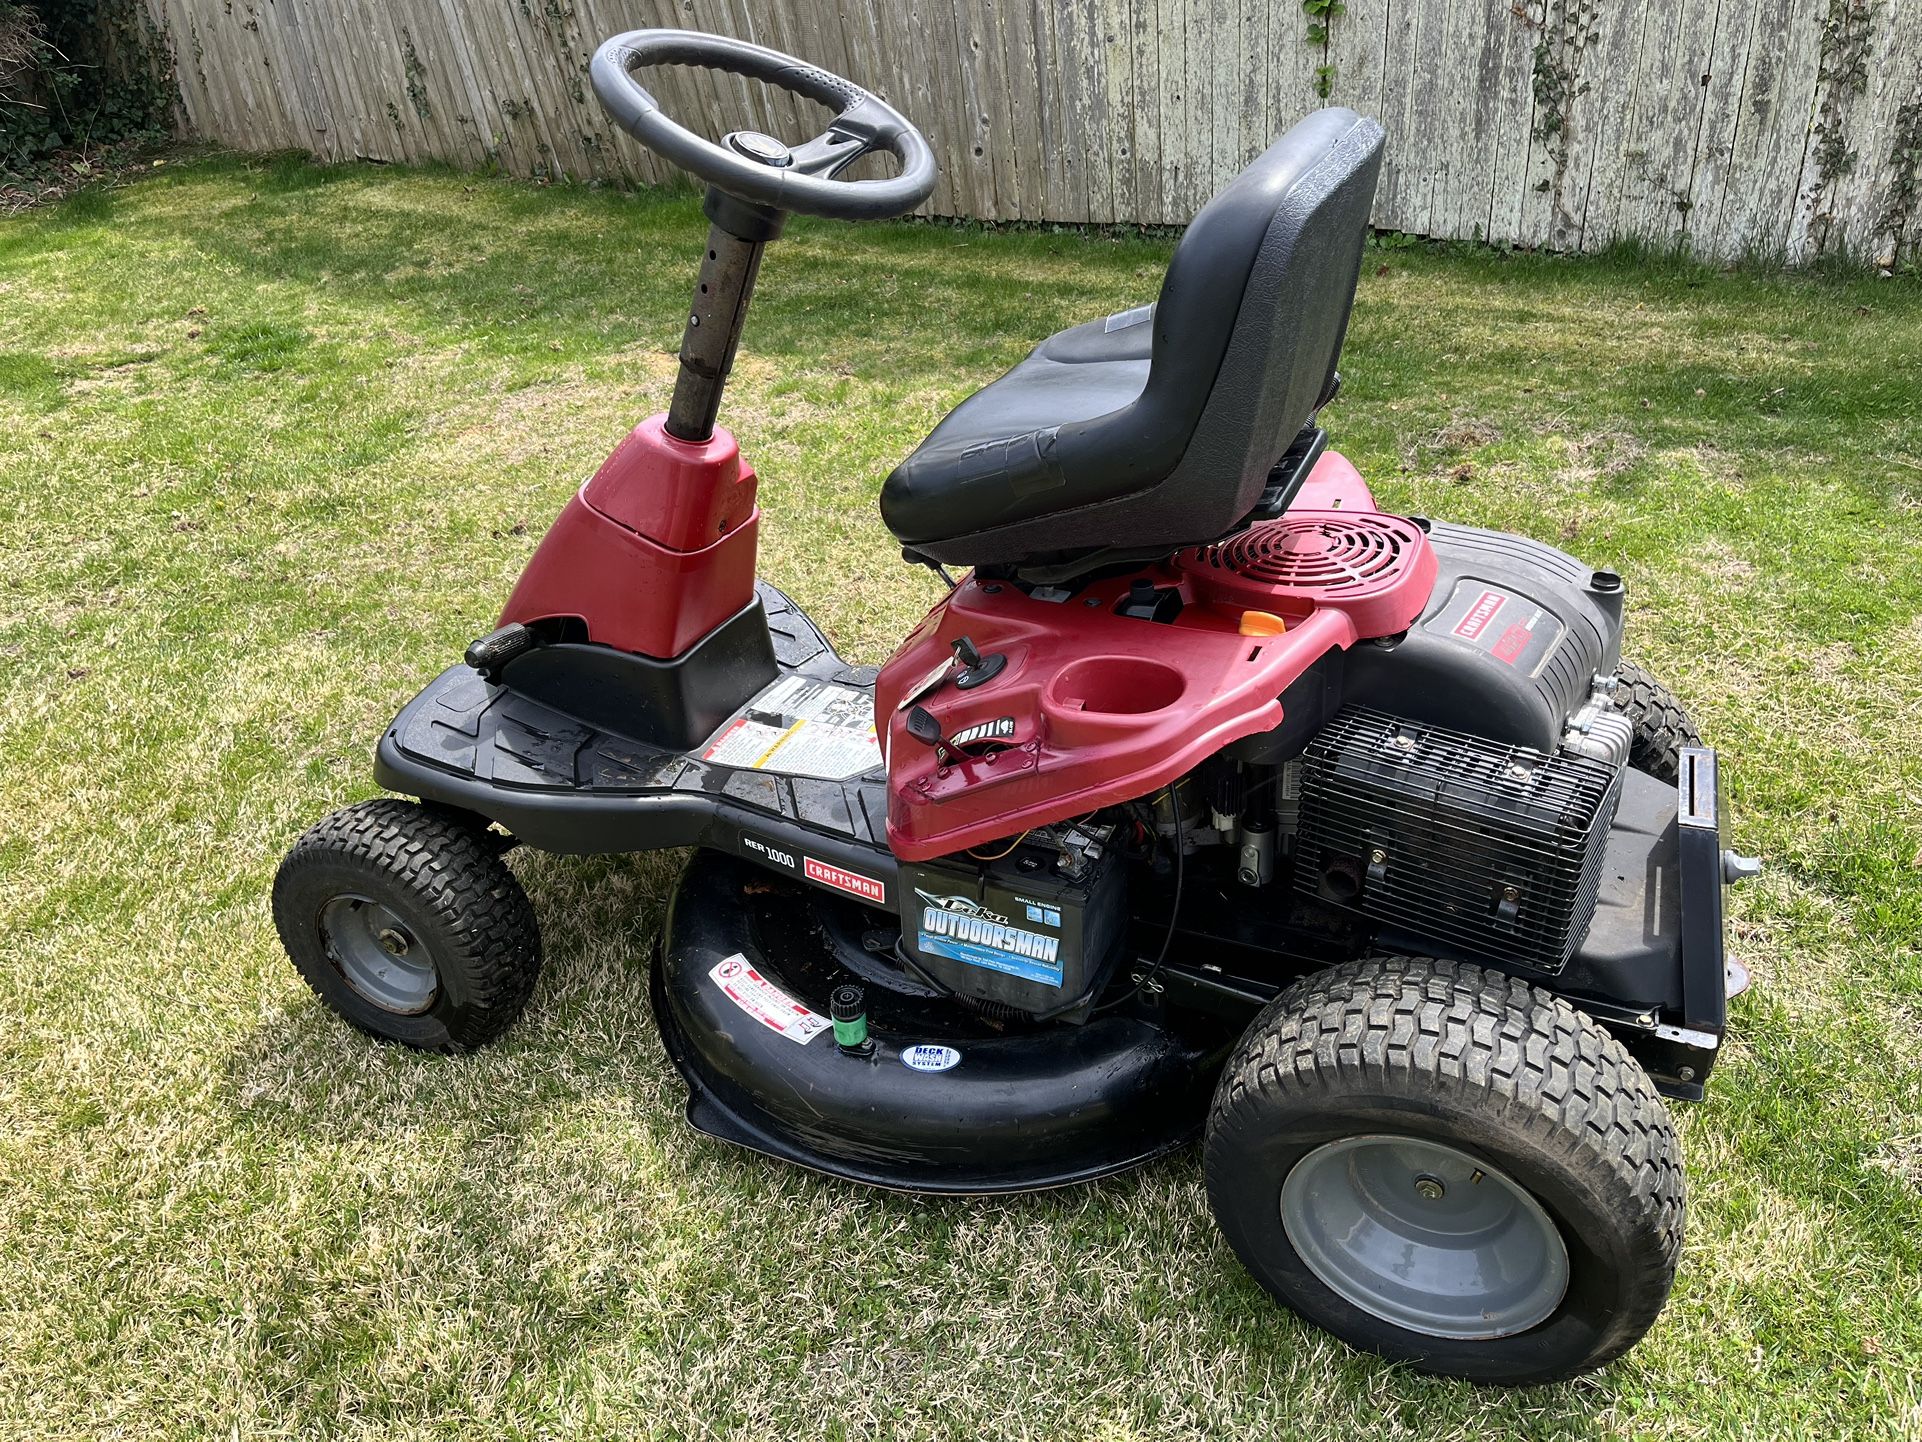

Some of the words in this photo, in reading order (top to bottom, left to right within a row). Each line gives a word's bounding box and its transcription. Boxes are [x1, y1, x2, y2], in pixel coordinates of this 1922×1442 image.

[1459, 594, 1500, 636] CRAFTSMAN
[744, 838, 765, 853] RER
[766, 846, 795, 869] 1000
[809, 863, 879, 897] CRAFTSMAN
[1014, 896, 1037, 906] SMALL
[1037, 901, 1062, 911] ENGINE
[923, 906, 1060, 964] OUTDOORSMAN
[915, 1046, 944, 1055] DECK
